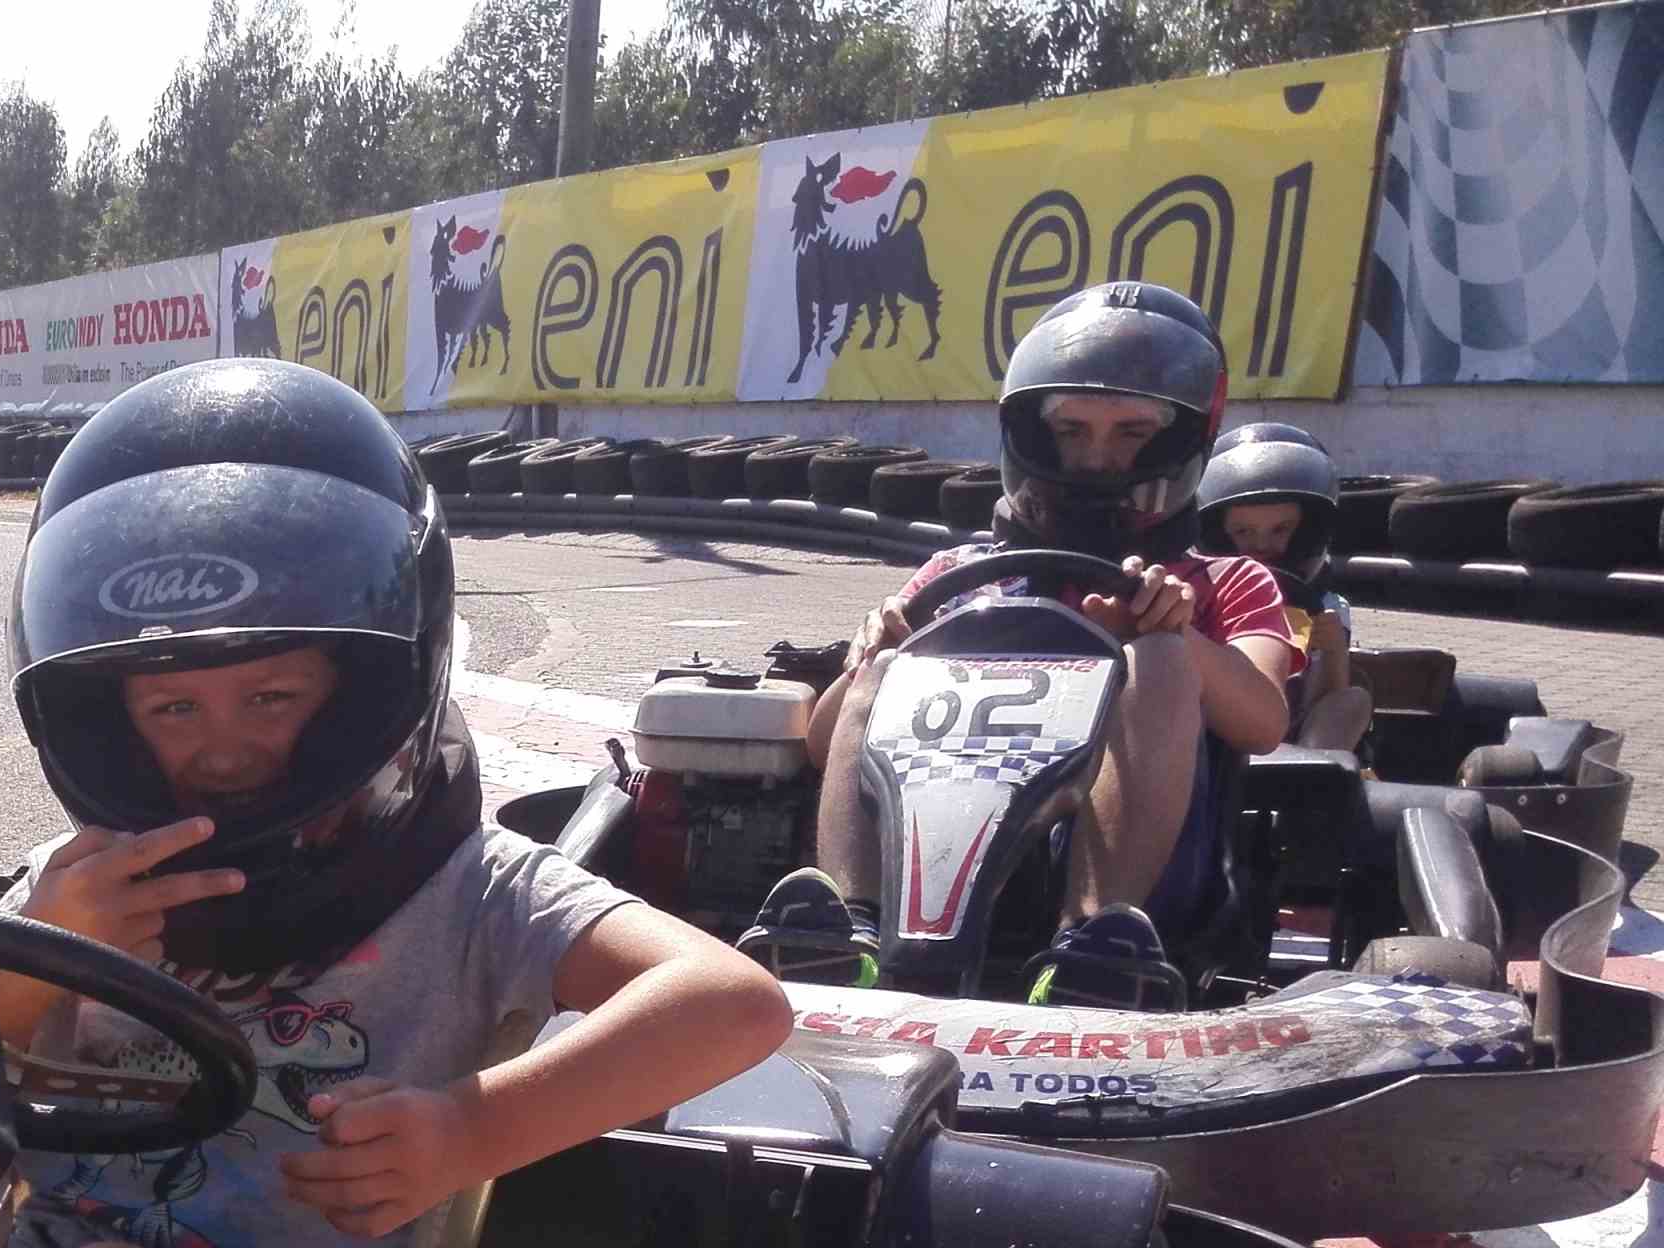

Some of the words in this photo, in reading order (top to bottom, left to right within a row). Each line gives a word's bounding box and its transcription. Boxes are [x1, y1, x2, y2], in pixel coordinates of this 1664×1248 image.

[984, 82, 1325, 380] eni
[531, 168, 730, 390] eni
[46, 313, 105, 351] EUROINDY
[113, 294, 212, 345] HONDA
[295, 226, 396, 400] eni
[963, 1014, 1314, 1061] KARTING
[1009, 1072, 1159, 1095] TODOS
